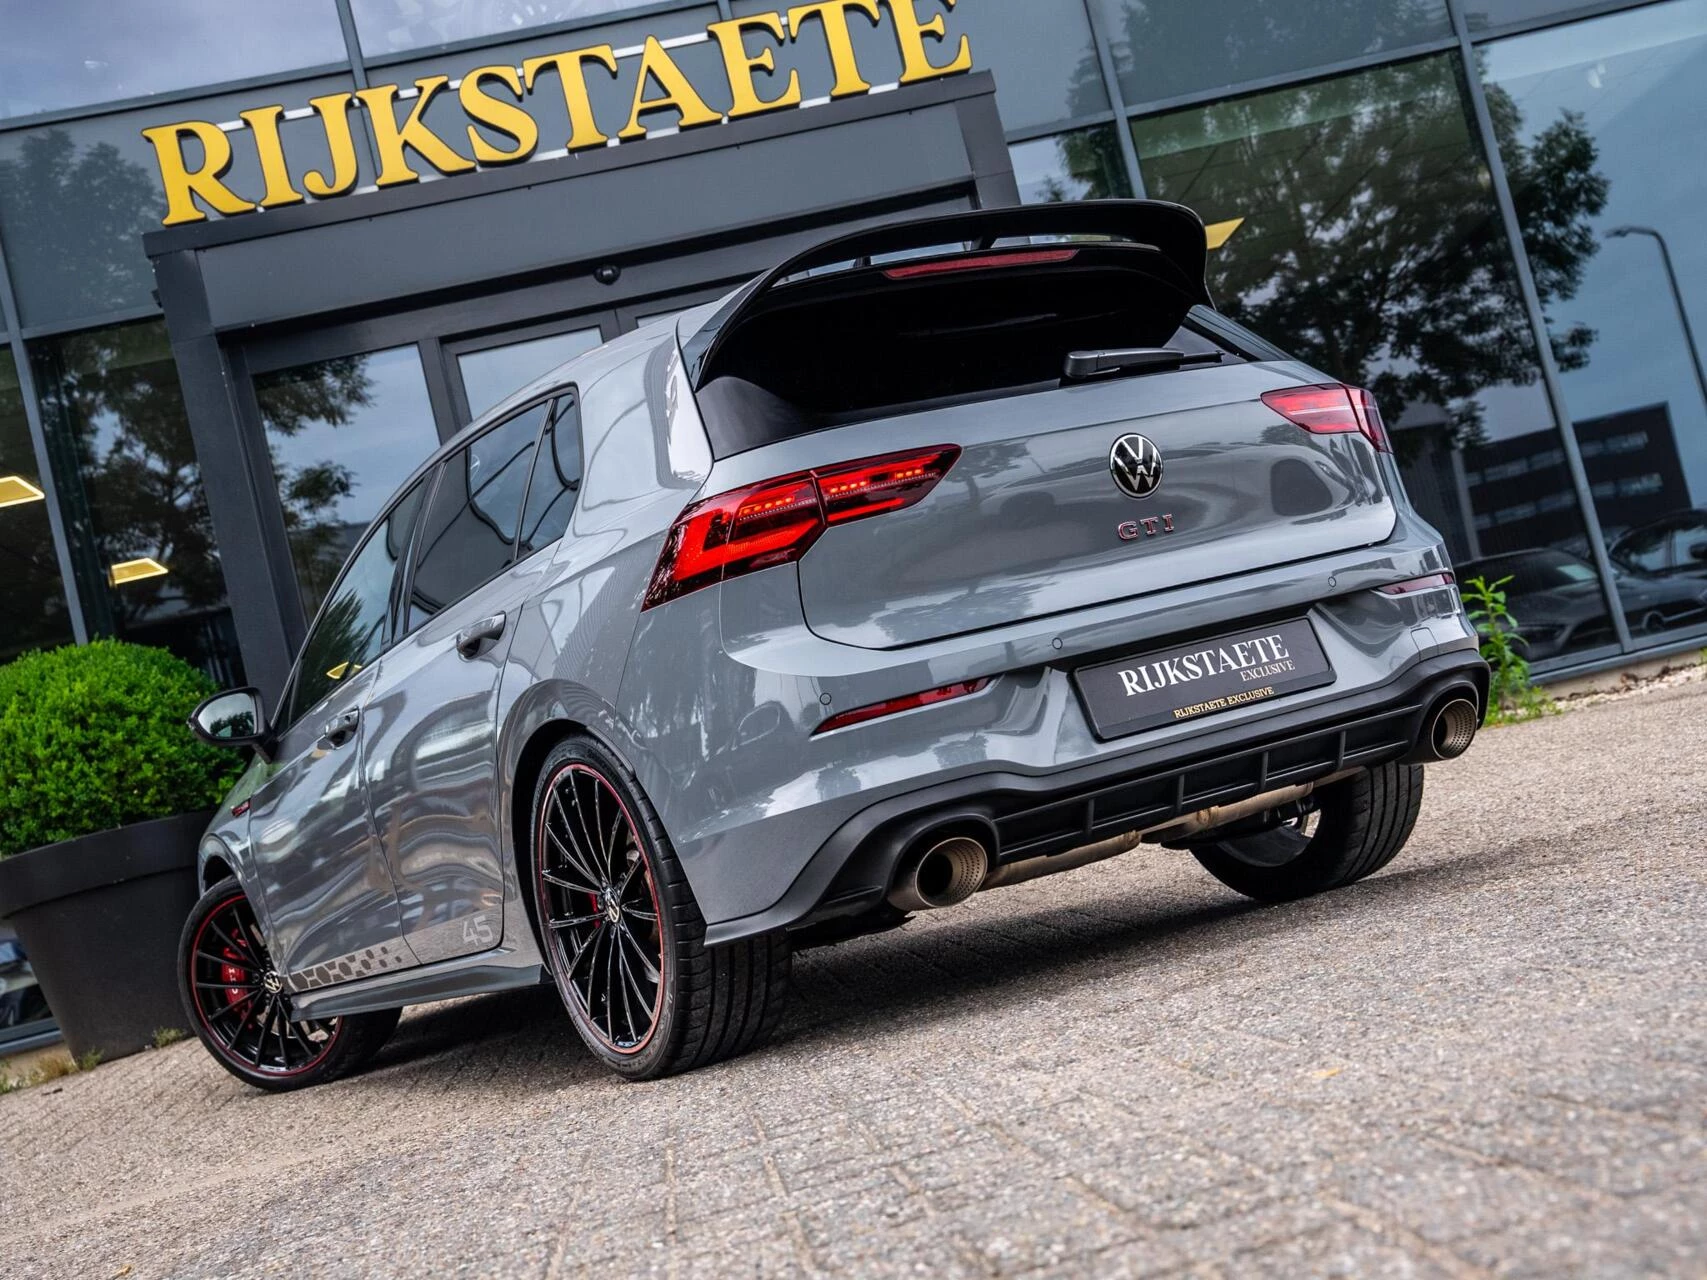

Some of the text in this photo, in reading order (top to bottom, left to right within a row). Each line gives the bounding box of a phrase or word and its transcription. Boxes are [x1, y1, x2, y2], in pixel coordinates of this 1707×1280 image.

[142, 0, 973, 227] RIJKSTAETE
[1117, 513, 1175, 541] GTI
[1117, 634, 1290, 697] RIJKSTAETE
[1240, 659, 1296, 682] EXCLUSIVE
[1173, 686, 1275, 719] RIJKSTAETE EXCLUSIVE
[462, 915, 494, 947] 45
